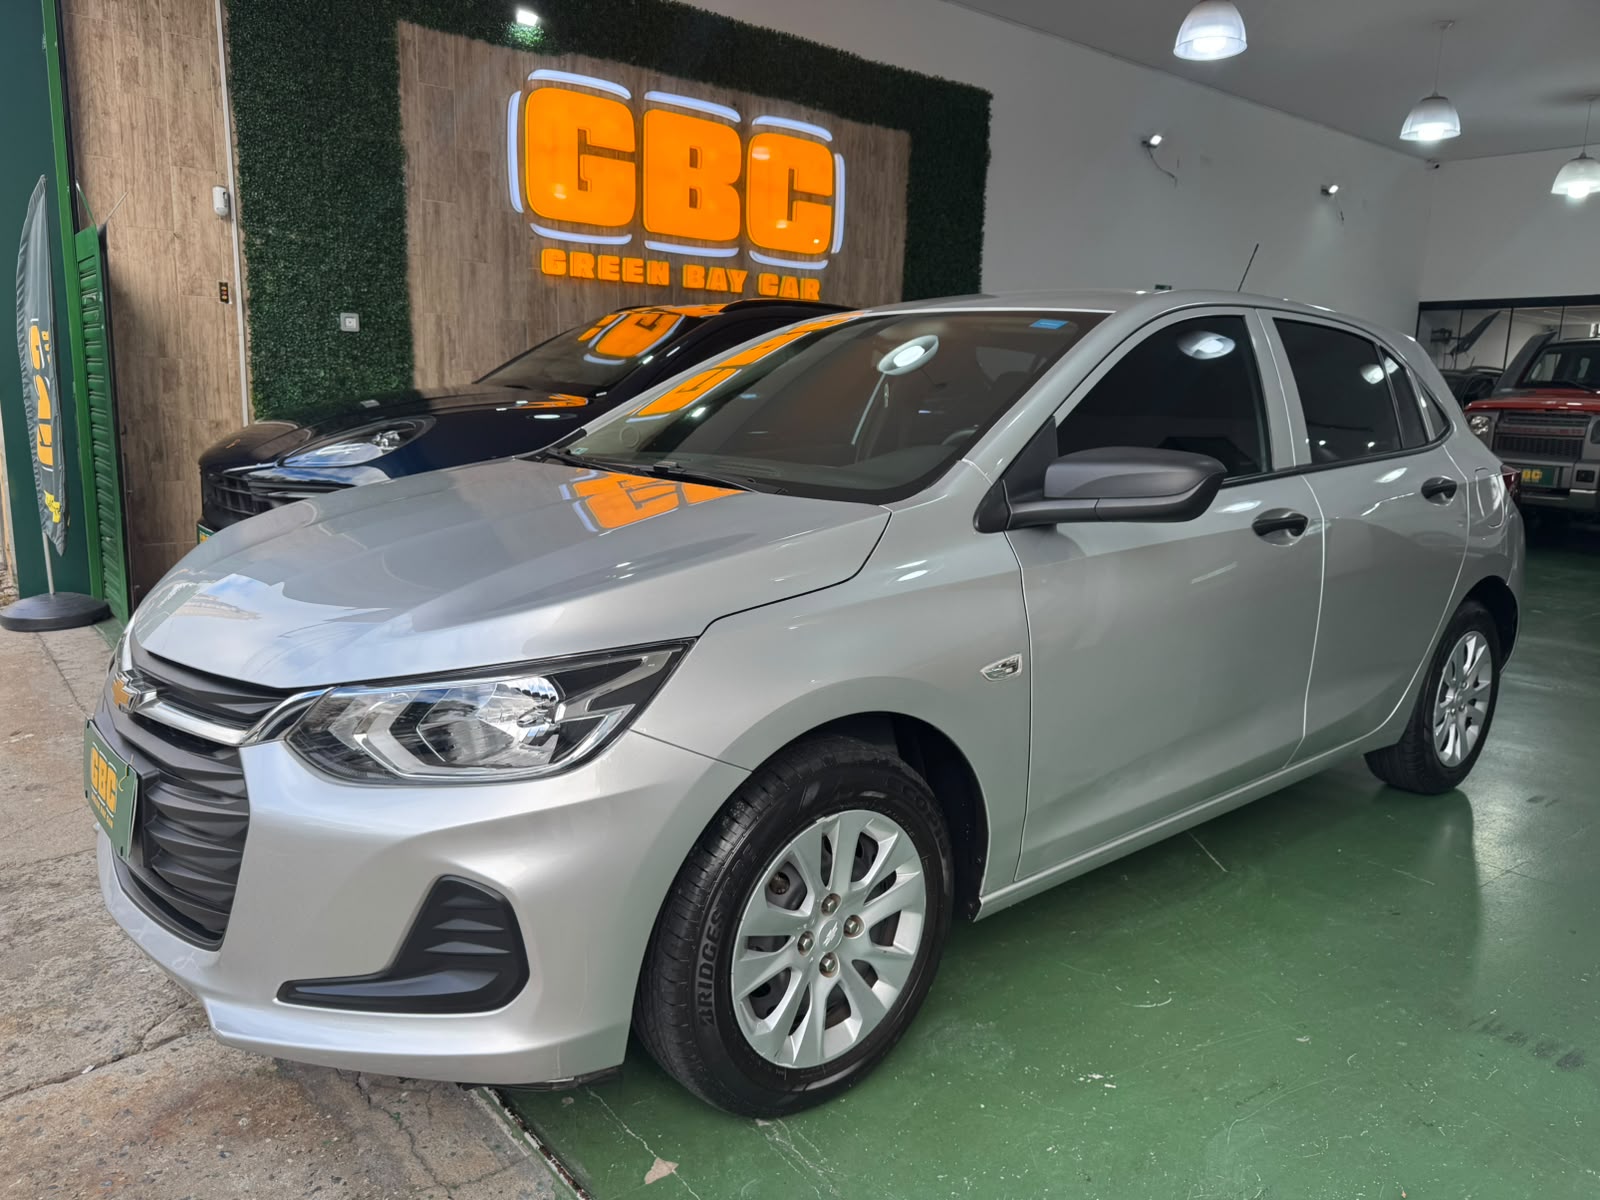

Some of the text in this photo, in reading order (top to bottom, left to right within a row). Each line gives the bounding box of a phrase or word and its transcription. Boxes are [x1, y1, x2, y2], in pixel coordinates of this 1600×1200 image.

[524, 86, 834, 256] GBC
[541, 248, 821, 301] GREEN BAY CAR
[91, 747, 117, 813] GBC
